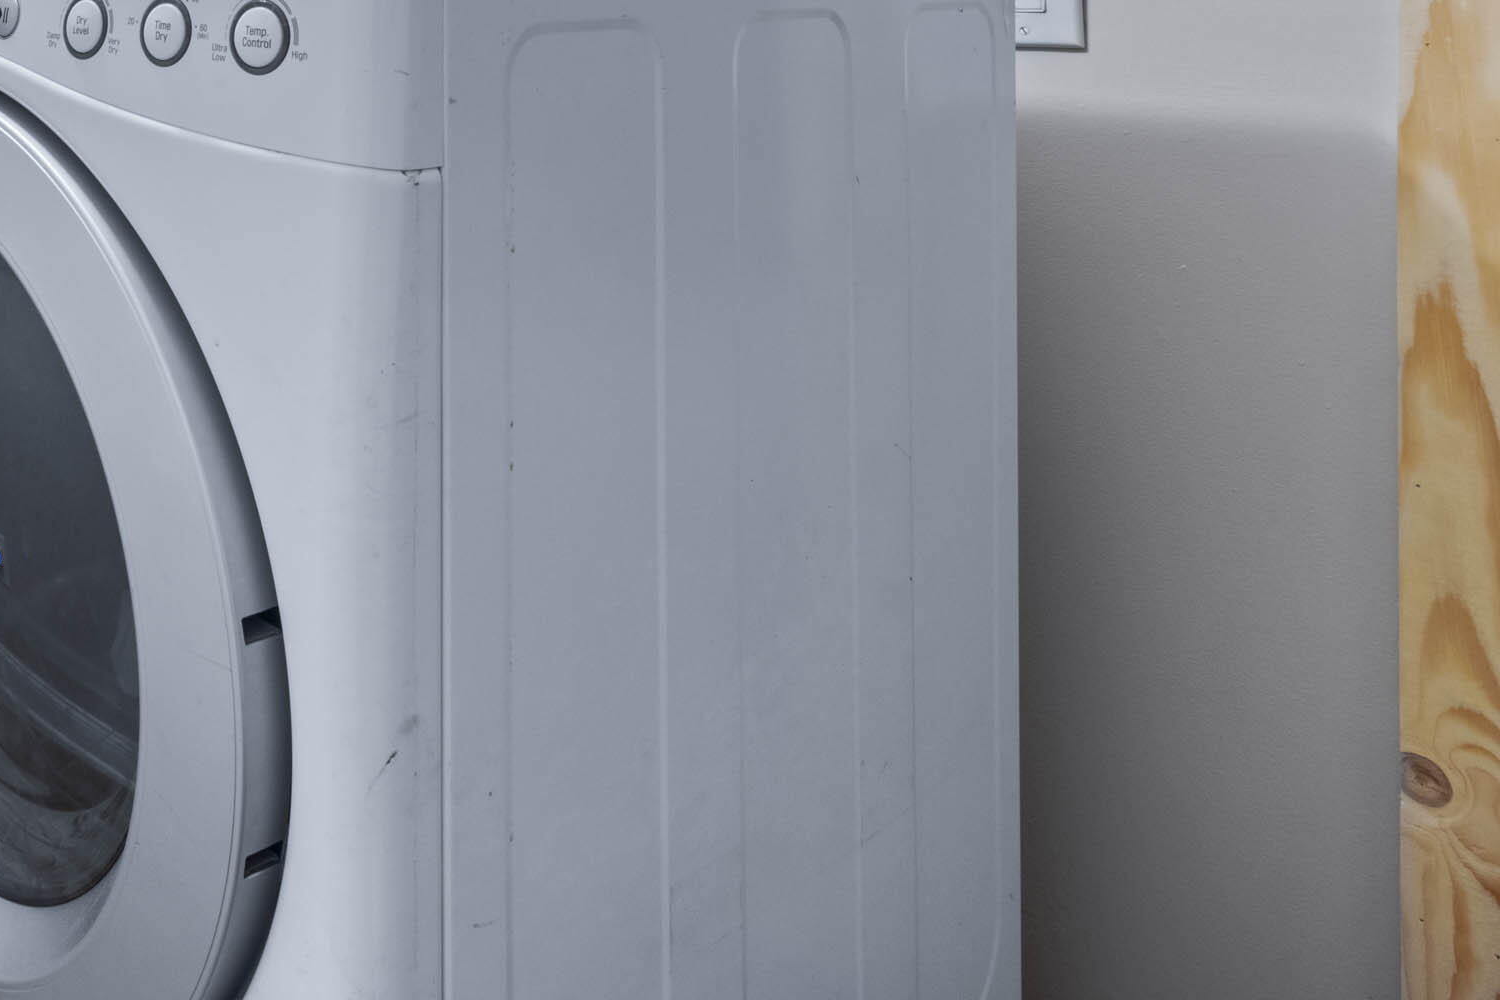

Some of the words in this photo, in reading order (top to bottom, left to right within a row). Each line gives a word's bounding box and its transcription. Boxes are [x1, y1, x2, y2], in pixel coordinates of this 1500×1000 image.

[76, 15, 88, 26] Dry
[127, 17, 135, 25] 20
[155, 20, 171, 31] Time
[72, 26, 90, 36] Level
[199, 24, 208, 32] 60
[245, 25, 269, 38] Temp.
[108, 38, 120, 46] Very
[155, 31, 168, 43] Dry
[48, 39, 57, 48] Dry
[211, 42, 228, 53] Ultra
[242, 36, 272, 49] Control
[108, 46, 118, 55] Dry
[291, 50, 308, 61] High
[211, 53, 227, 62] Low
